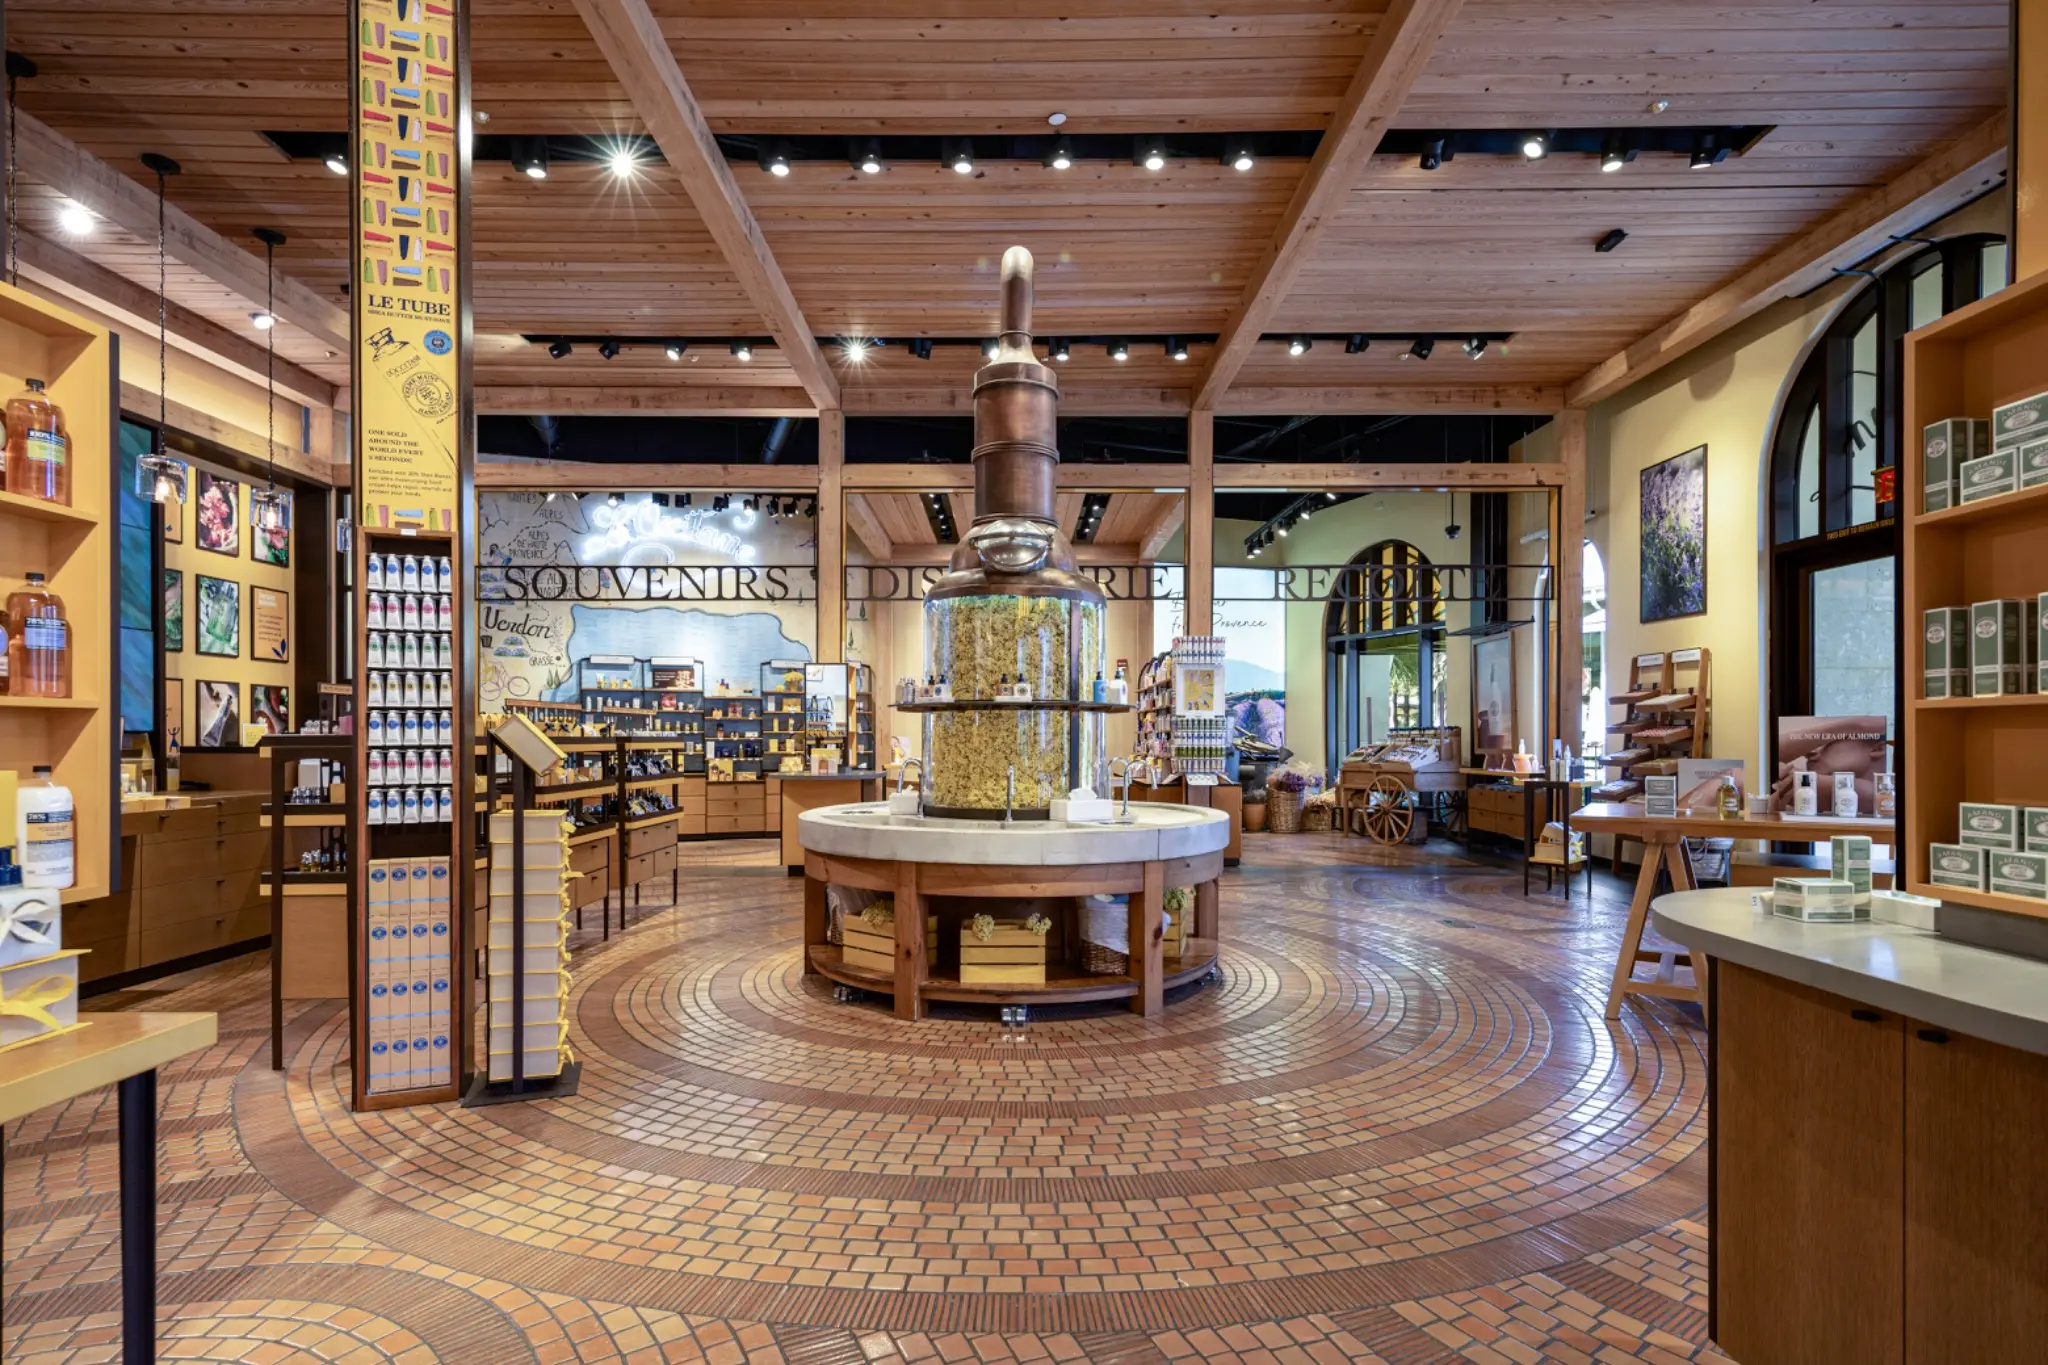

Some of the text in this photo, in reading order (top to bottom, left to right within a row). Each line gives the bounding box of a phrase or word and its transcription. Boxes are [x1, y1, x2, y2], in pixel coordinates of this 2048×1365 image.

[368, 294, 450, 316] LE TUBE
[368, 438, 402, 446] AROUND
[368, 446, 424, 456] WORLD EVERY
[504, 566, 789, 600] SOUVENIRS
[483, 606, 553, 639] Verdon
[529, 656, 555, 667] GRASSE
